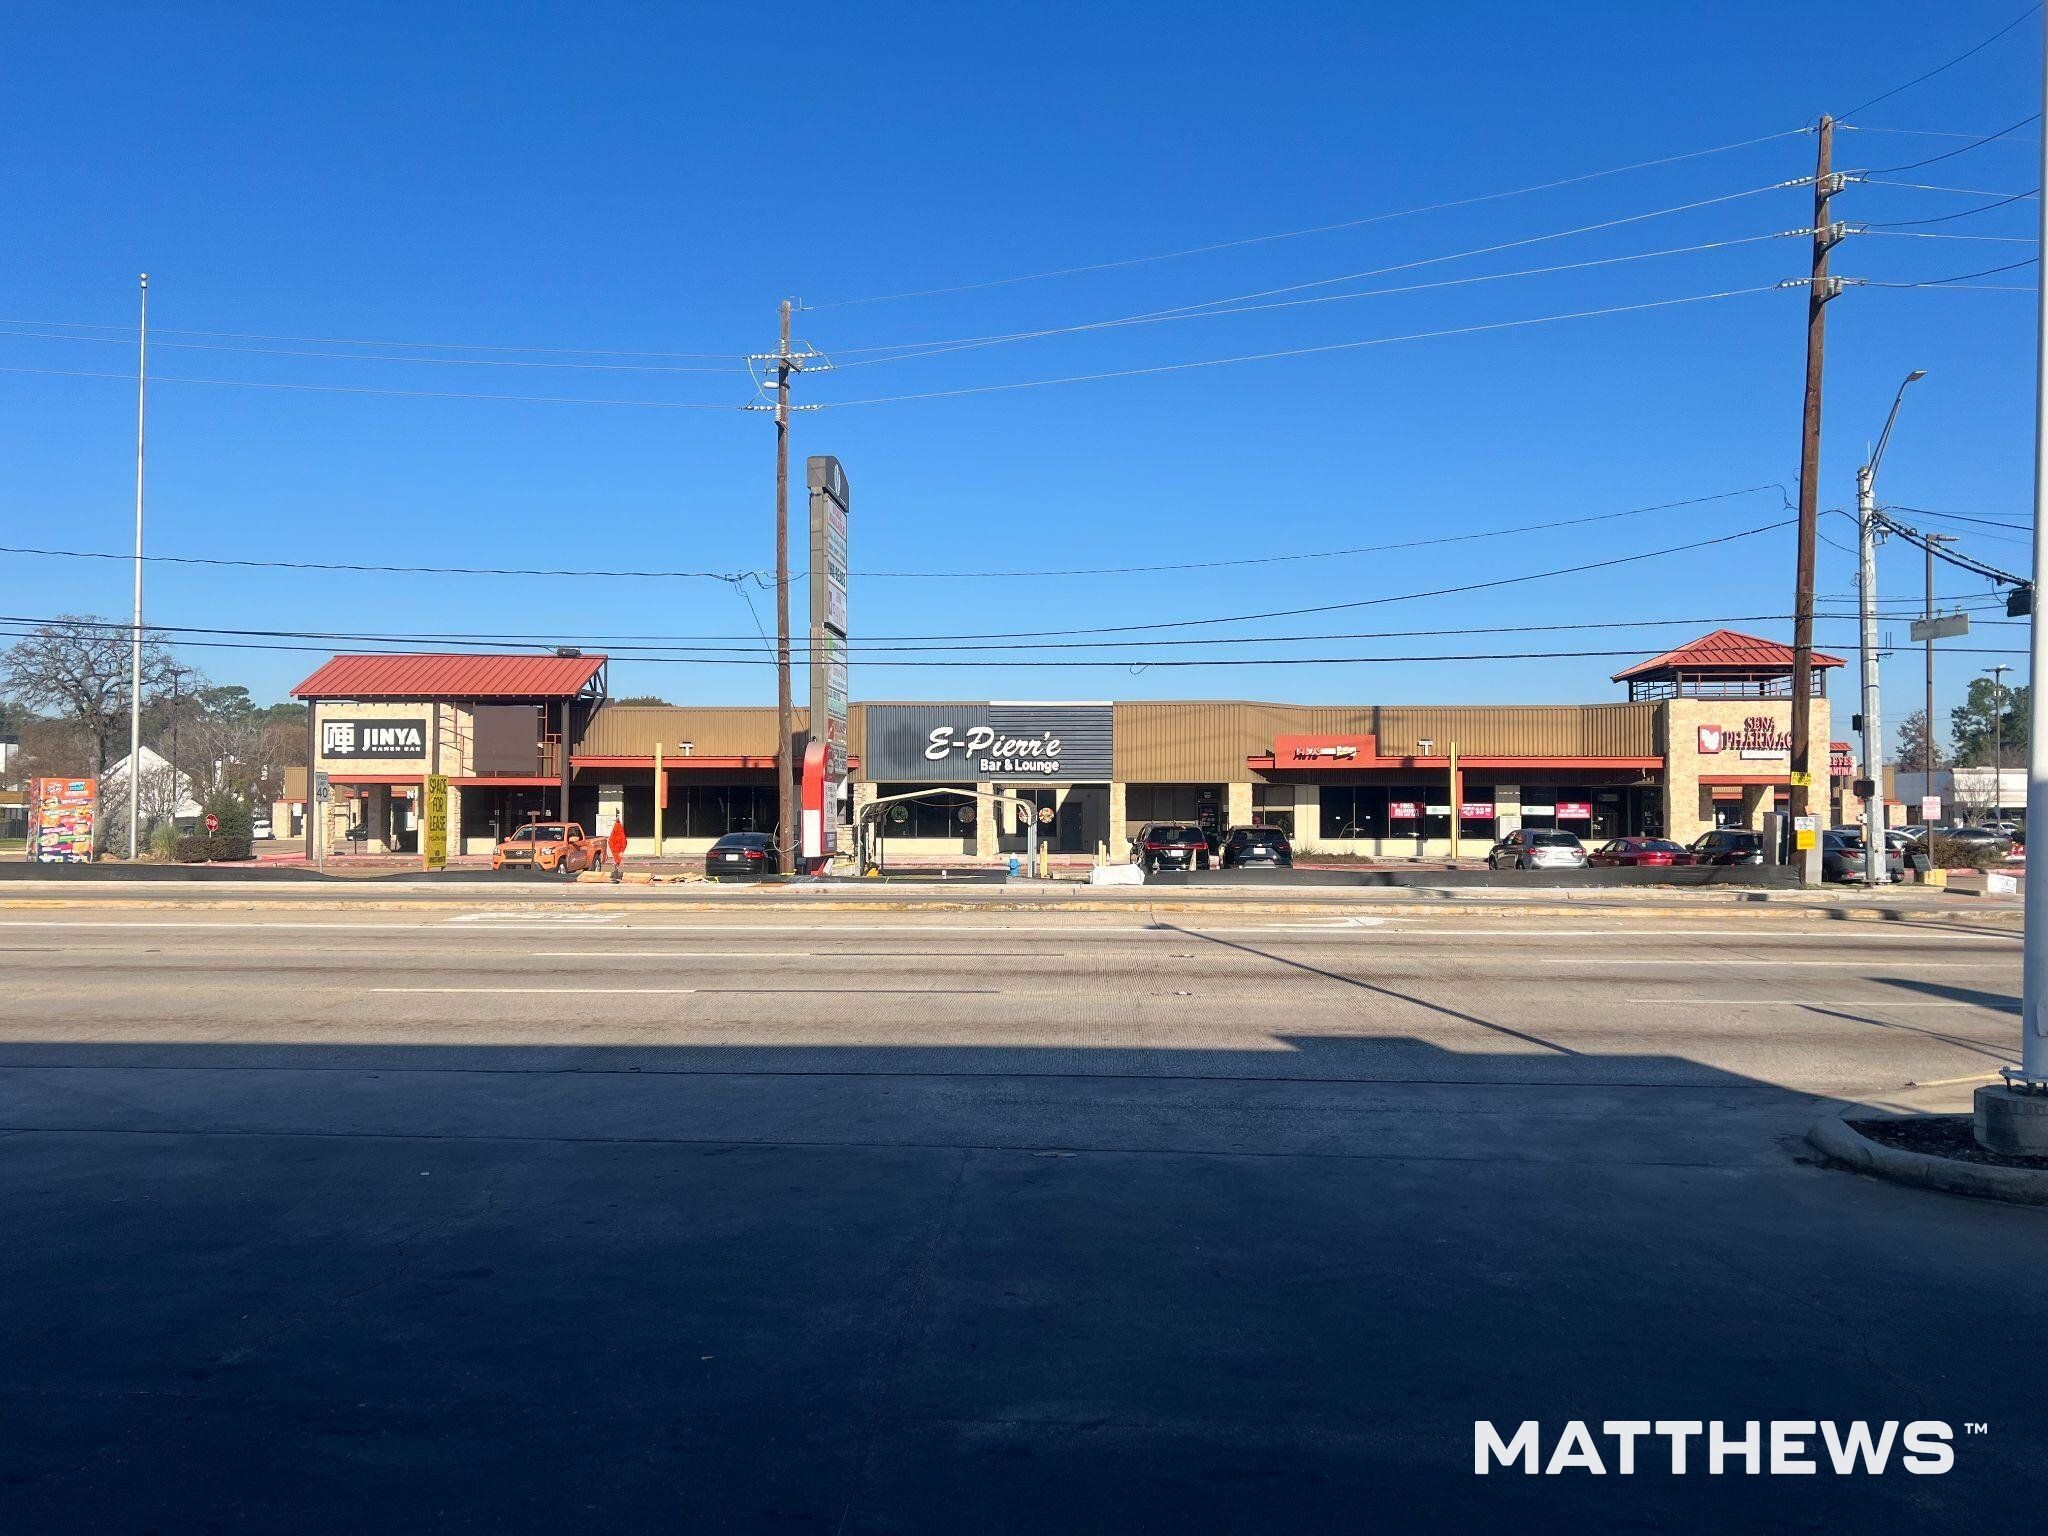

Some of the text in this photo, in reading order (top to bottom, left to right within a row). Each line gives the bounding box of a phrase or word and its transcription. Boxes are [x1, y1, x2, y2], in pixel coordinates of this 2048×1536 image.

[1744, 716, 1775, 731] SENA
[362, 728, 421, 751] JINYA
[924, 726, 1062, 760] E-Pierr'e
[1723, 731, 1793, 750] PHARMAC
[980, 758, 1060, 774] Bar & Lounge
[317, 787, 328, 798] 40
[429, 778, 447, 794] SPACE
[432, 796, 444, 813] FOR
[429, 815, 446, 832] LEASE
